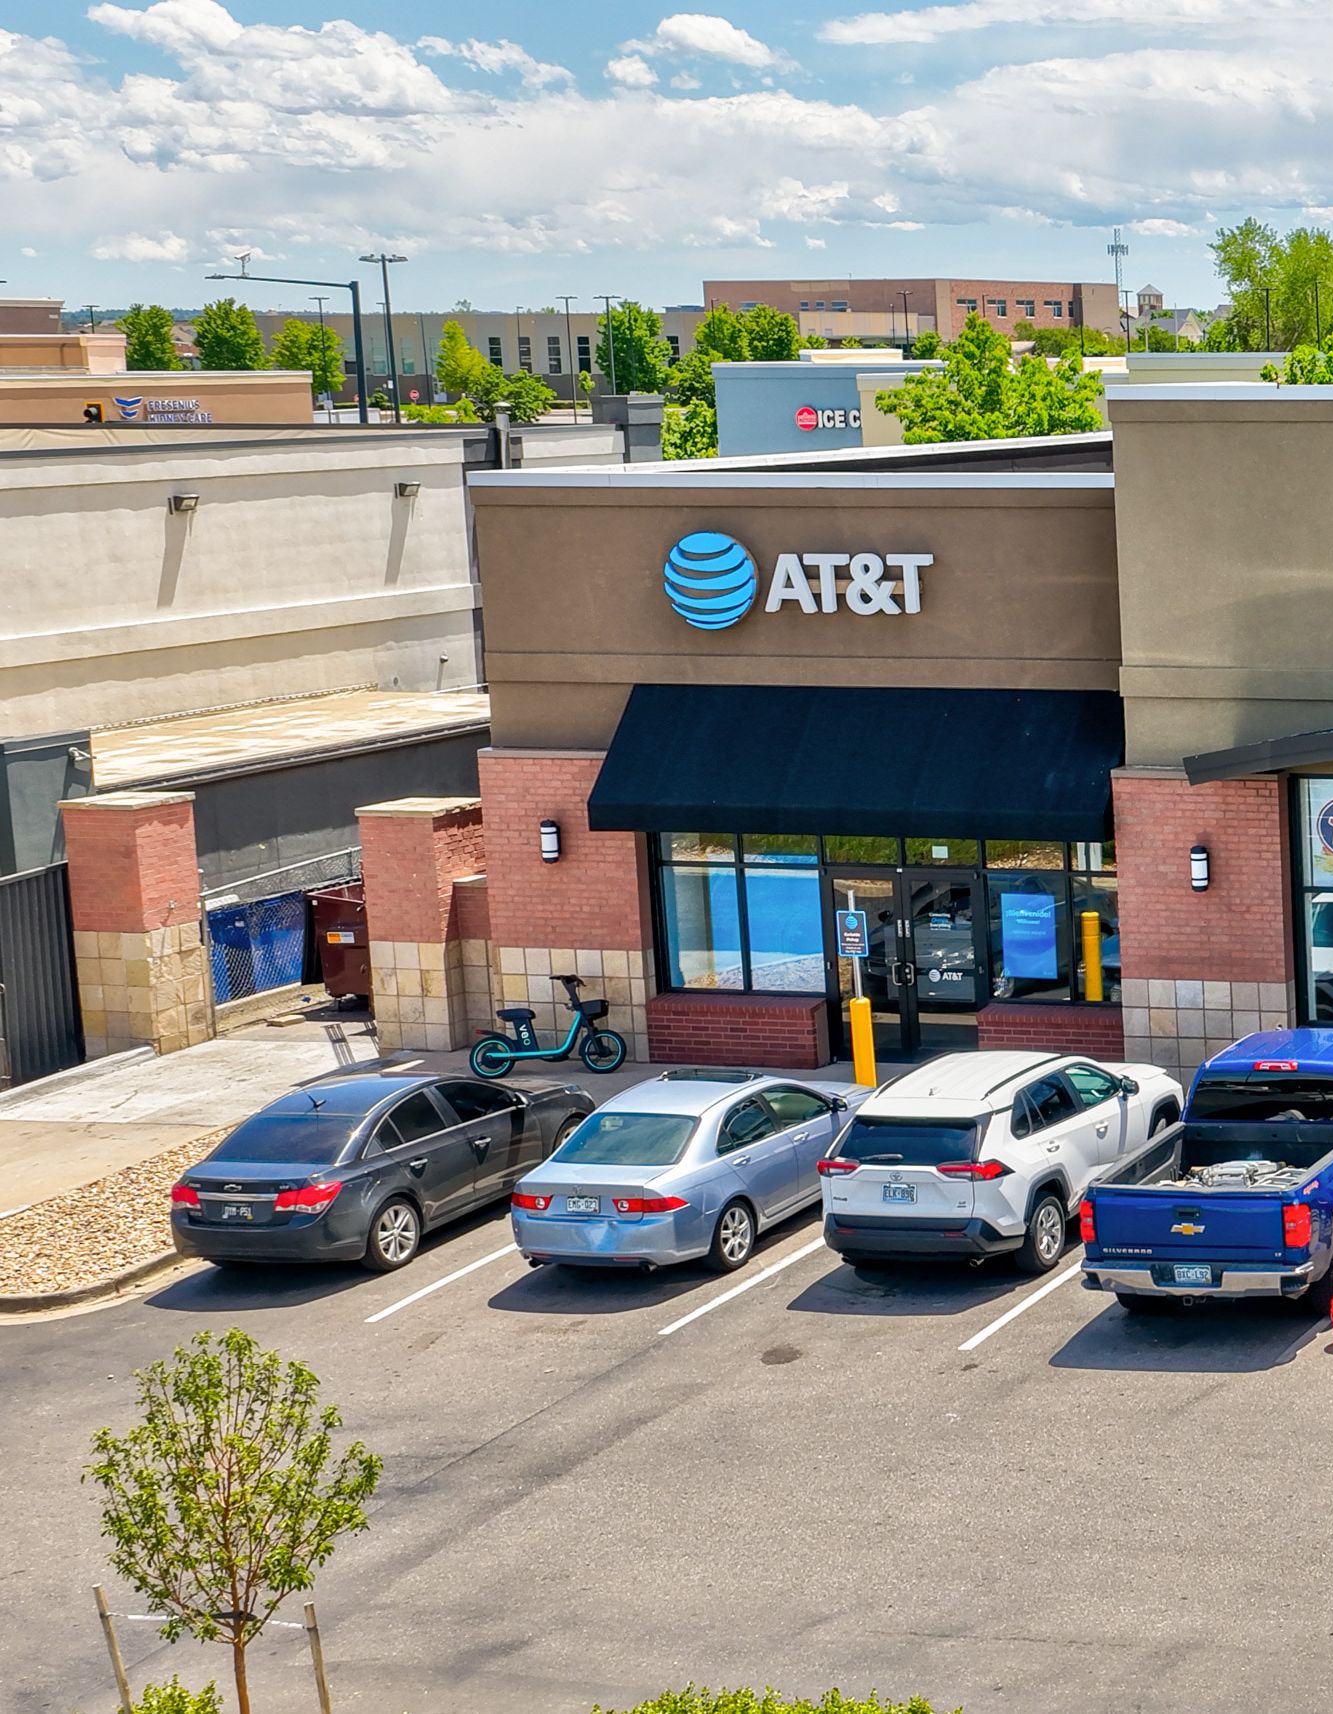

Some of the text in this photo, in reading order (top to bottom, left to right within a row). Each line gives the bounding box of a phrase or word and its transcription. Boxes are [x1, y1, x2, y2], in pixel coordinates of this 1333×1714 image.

[148, 400, 200, 410] FRESENIUS
[817, 409, 846, 428] ICE
[764, 553, 934, 615] AT&T
[942, 972, 963, 981] AT&T
